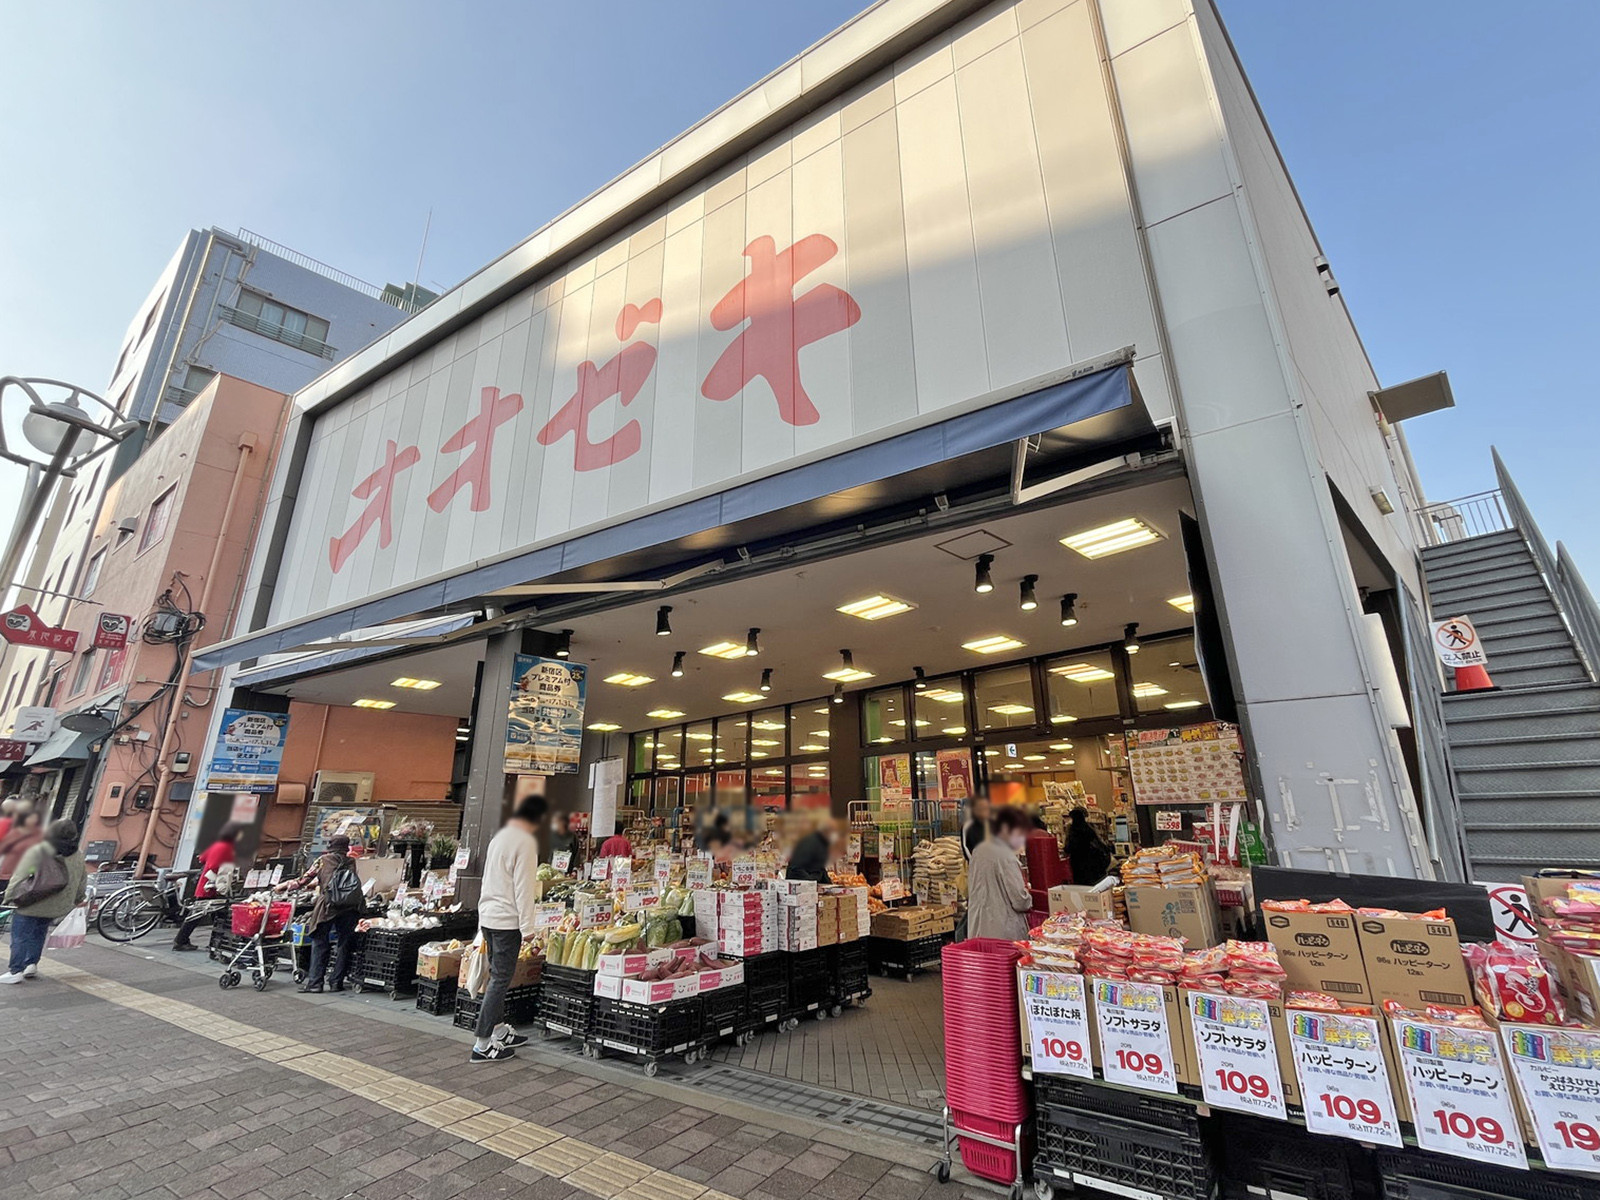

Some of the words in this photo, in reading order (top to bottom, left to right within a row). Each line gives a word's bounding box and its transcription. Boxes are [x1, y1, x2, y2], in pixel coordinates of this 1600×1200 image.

[329, 233, 861, 574] オオゼキ
[1442, 651, 1482, 661] 立入禁止
[531, 674, 571, 686] プレミアム付
[1298, 950, 1348, 960] ハッピーターン
[1393, 958, 1450, 969] ハッピーターン
[1103, 1015, 1161, 1032] ソフトサラダ
[1200, 1031, 1267, 1052] ソフトサラダ
[1324, 1027, 1372, 1049] 菓子祭
[1437, 1040, 1493, 1064] 菓子祭
[1302, 1052, 1377, 1074] ハッピーターン
[1530, 1064, 1559, 1073] カルビー
[1412, 1066, 1499, 1090] ハッピーターン
